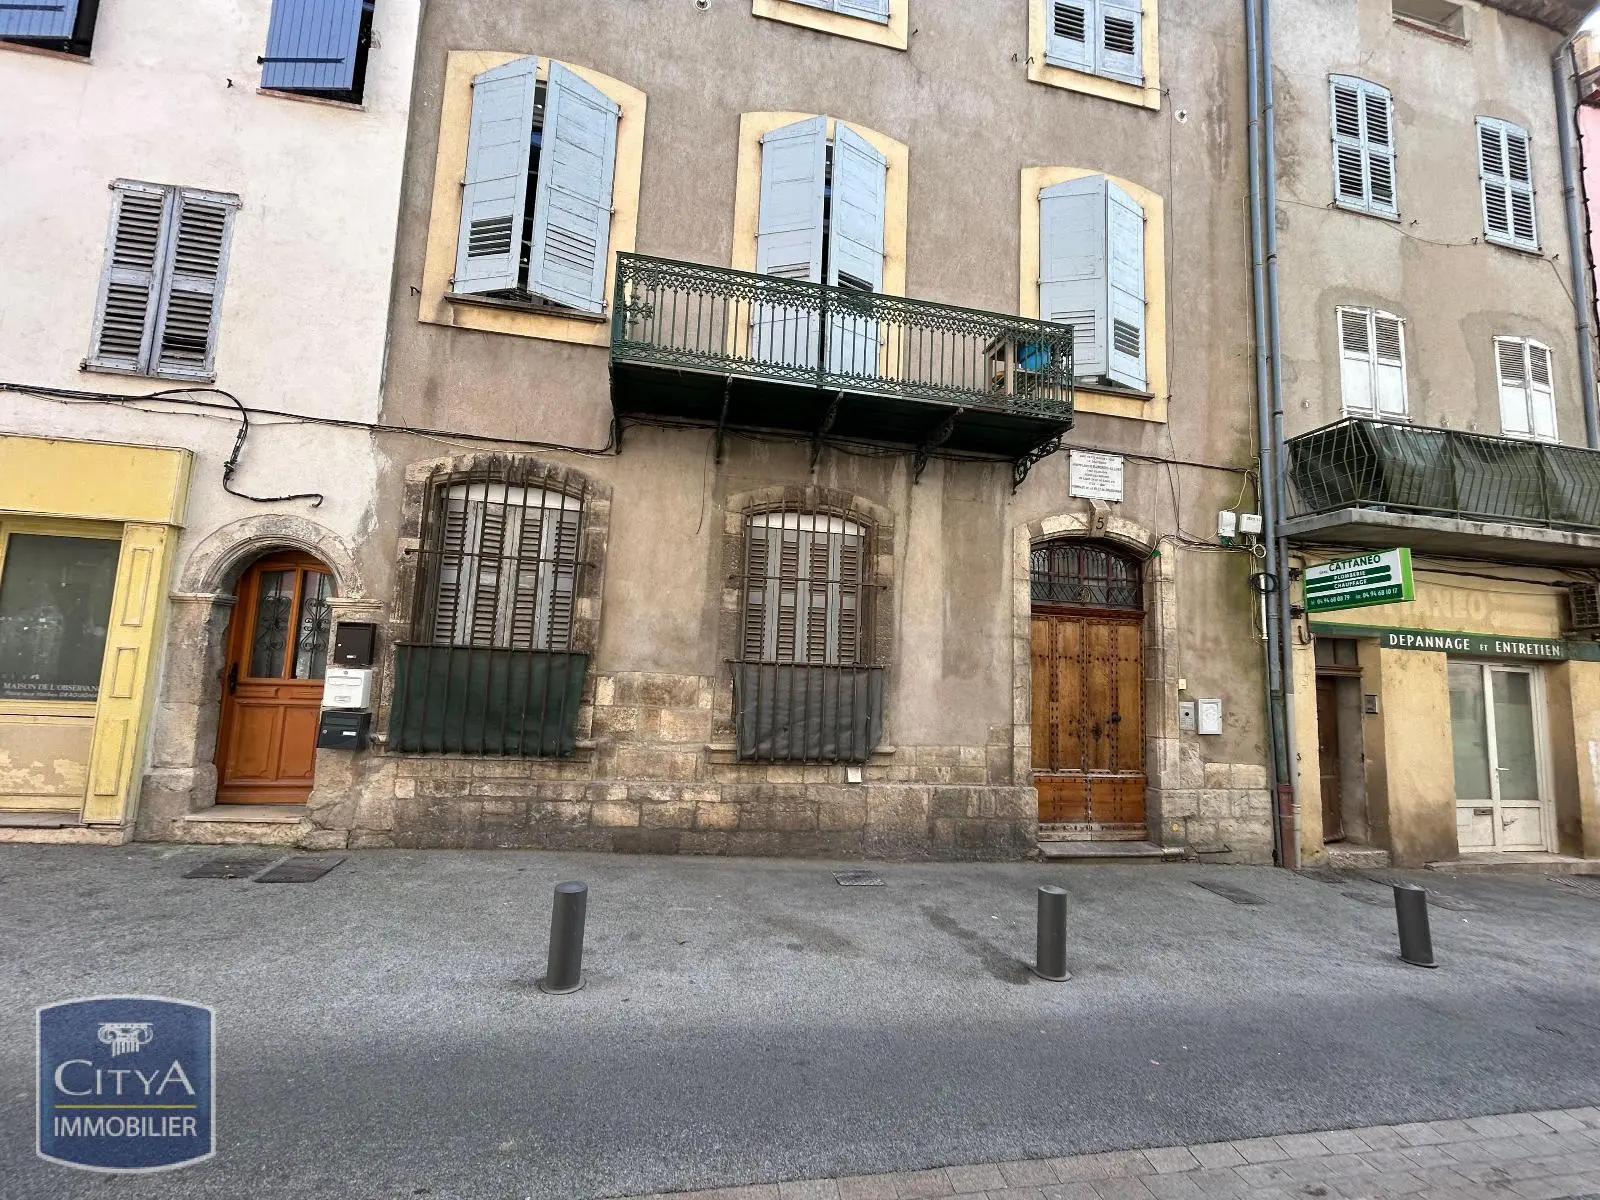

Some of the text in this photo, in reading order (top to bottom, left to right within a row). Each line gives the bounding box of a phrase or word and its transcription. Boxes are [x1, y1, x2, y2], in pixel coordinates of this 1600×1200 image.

[1096, 517, 1104, 530] 5
[1328, 554, 1381, 572] CATTANEO
[1334, 571, 1366, 580] PLOMBERIE
[1334, 578, 1368, 589] CHAUFFAGE
[1389, 634, 1470, 650] DEPANNAGE
[1496, 640, 1560, 656] ENTRETIEN
